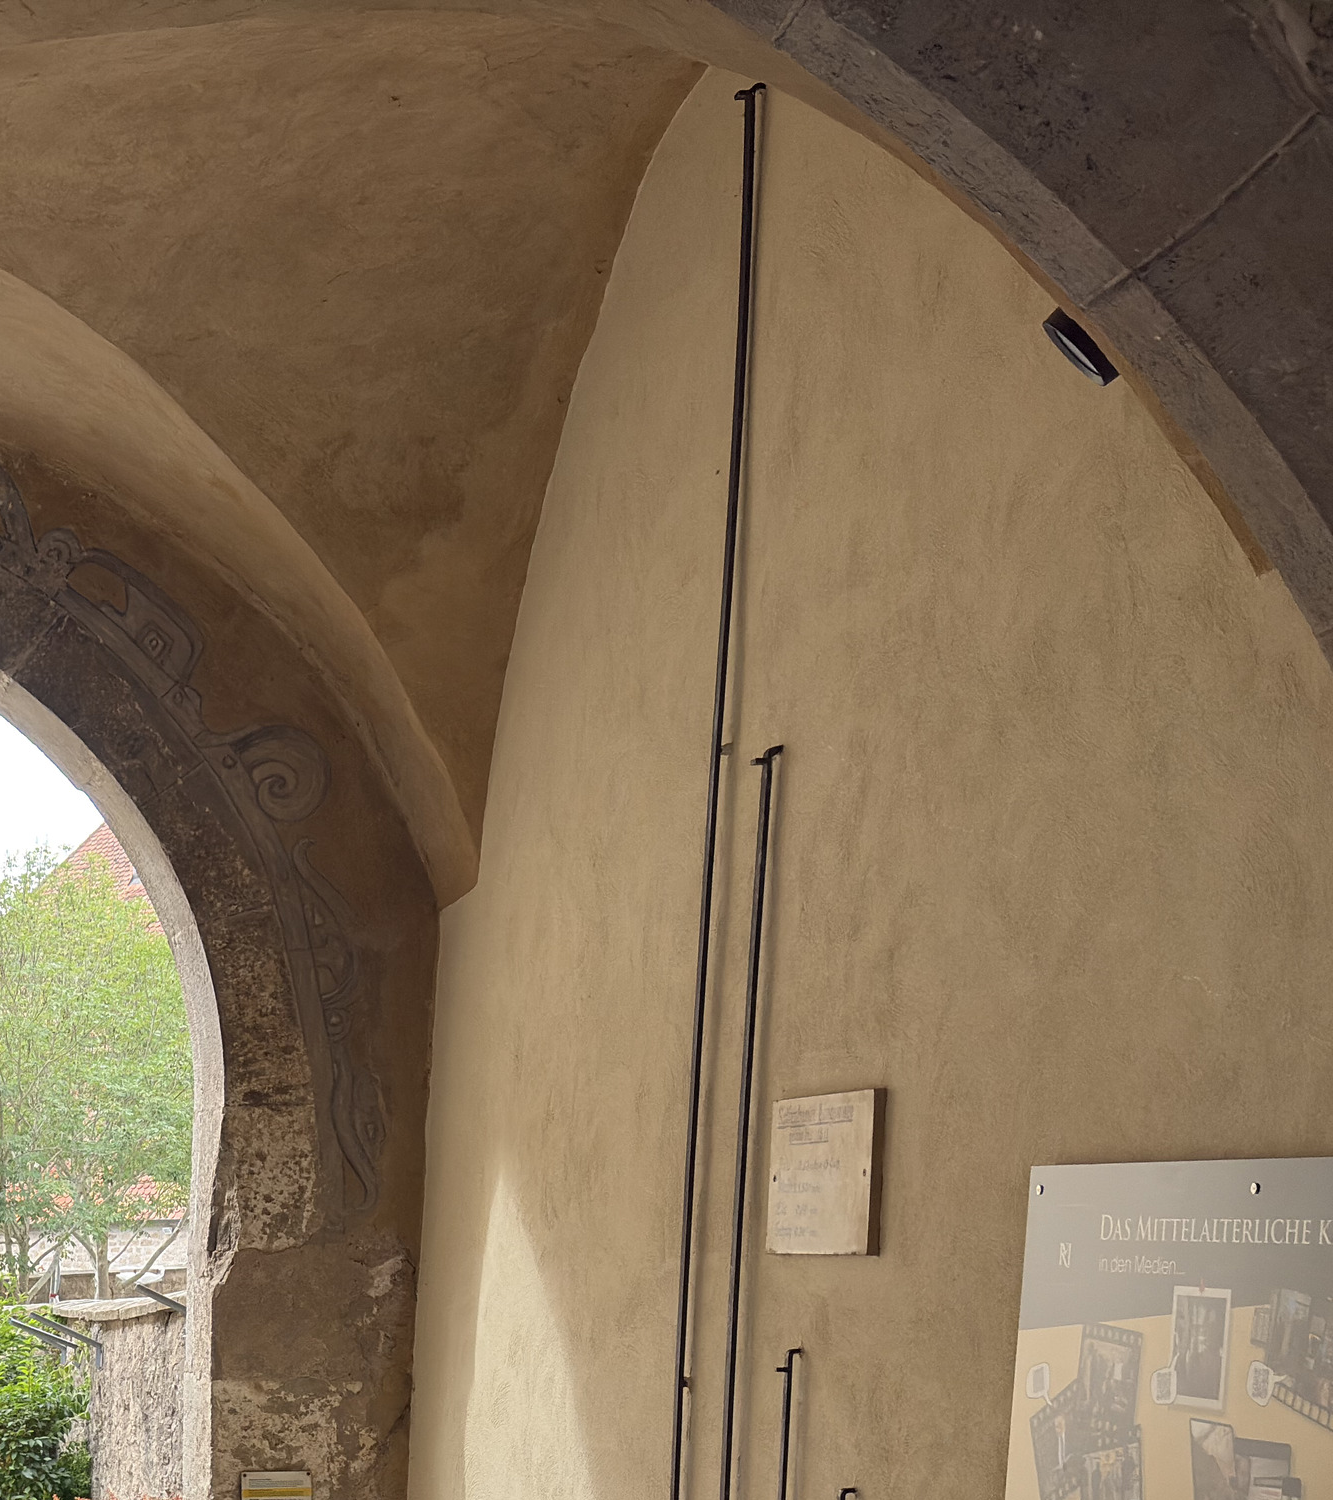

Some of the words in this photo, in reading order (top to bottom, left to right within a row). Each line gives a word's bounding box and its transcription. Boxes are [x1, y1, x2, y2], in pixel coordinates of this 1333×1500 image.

[1100, 1214, 1132, 1241] DAS
[1135, 1215, 1312, 1245] MITTELALTERLICHE
[1098, 1256, 1108, 1272] in
[1109, 1256, 1132, 1274] den
